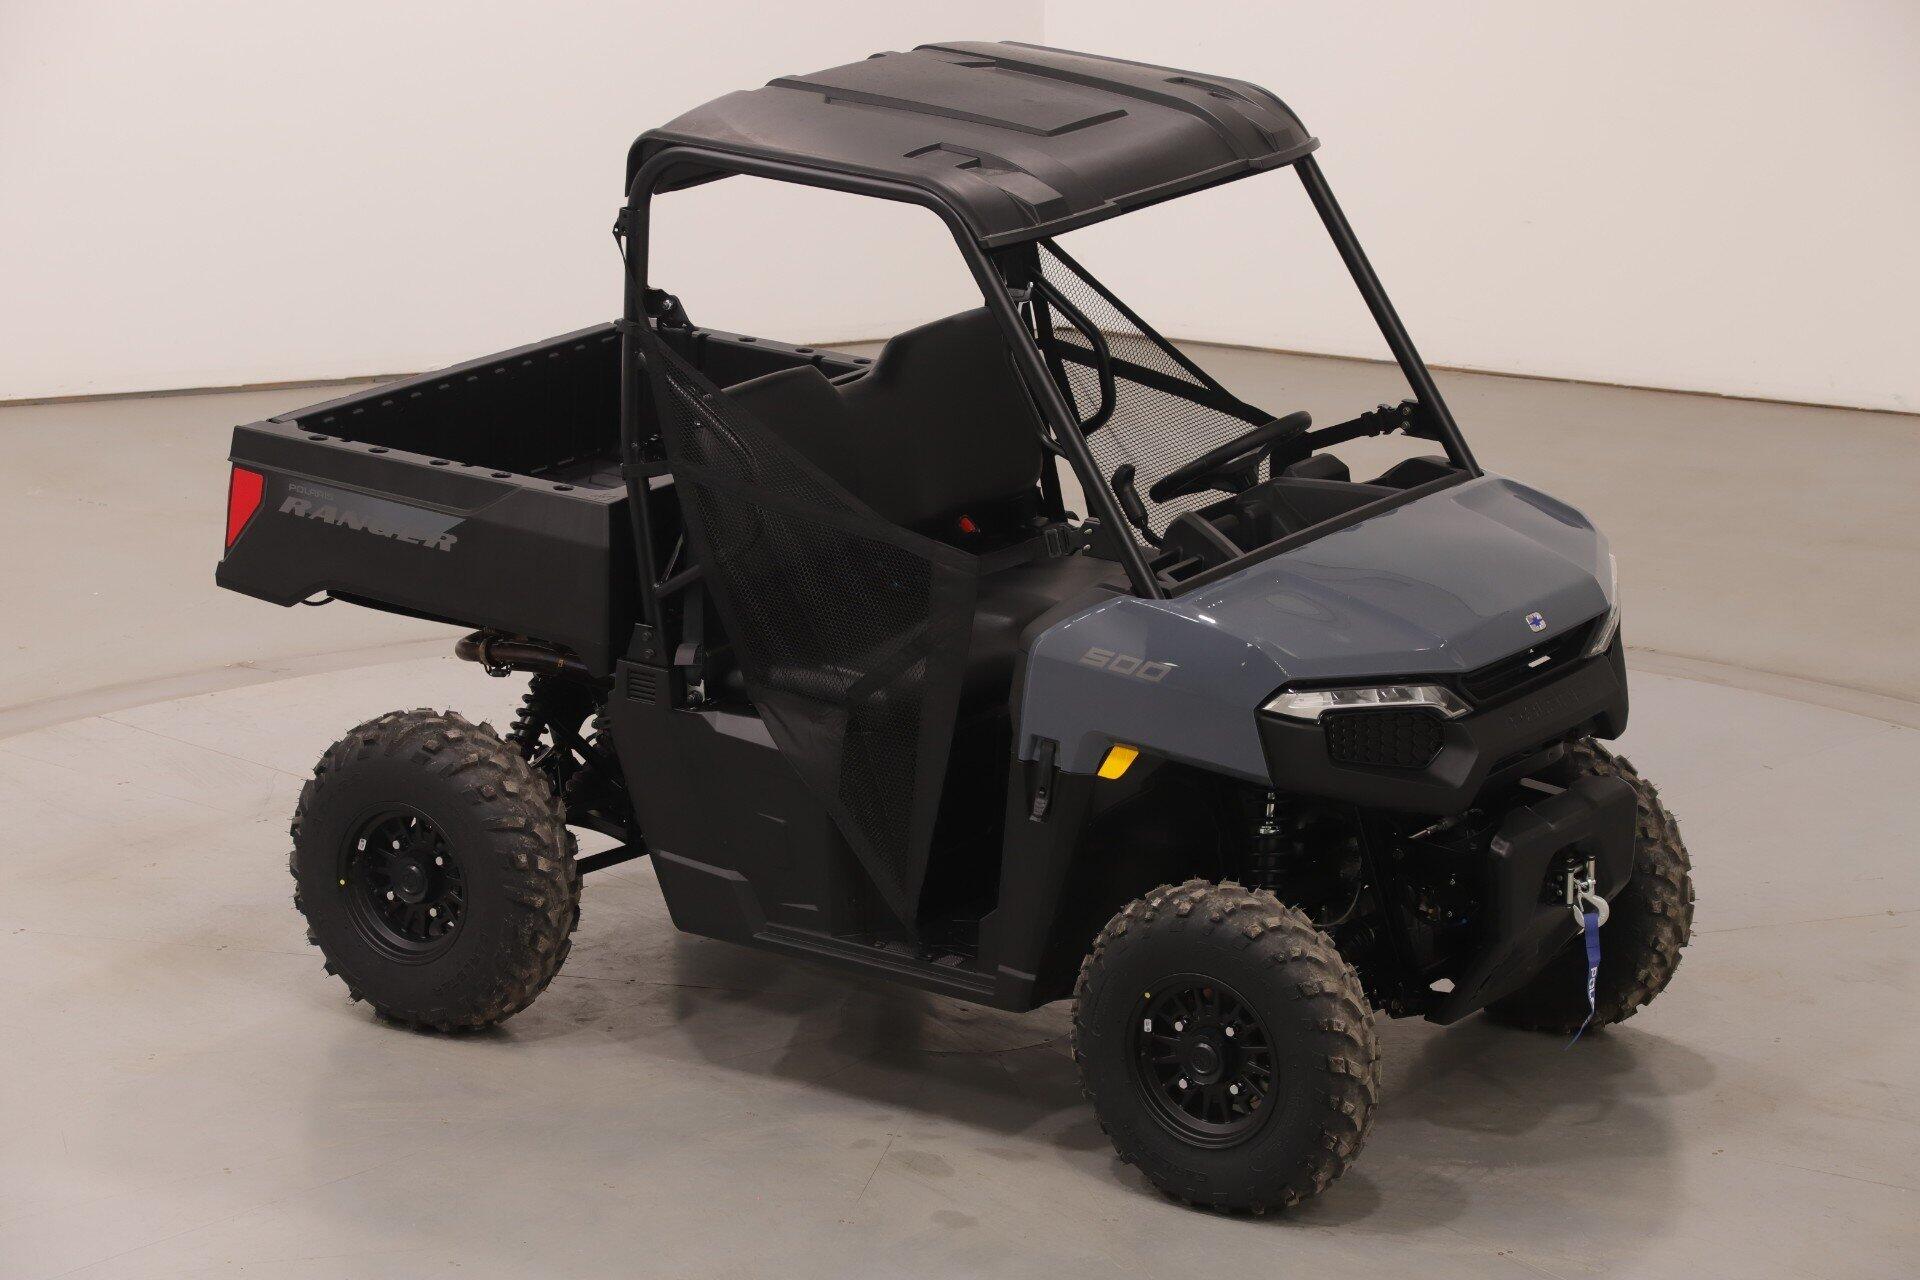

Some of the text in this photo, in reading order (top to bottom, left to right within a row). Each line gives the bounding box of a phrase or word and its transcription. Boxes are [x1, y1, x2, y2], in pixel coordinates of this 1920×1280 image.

[288, 483, 334, 501] POLARIS
[278, 496, 458, 552] RANGER
[1079, 646, 1172, 683] 500
